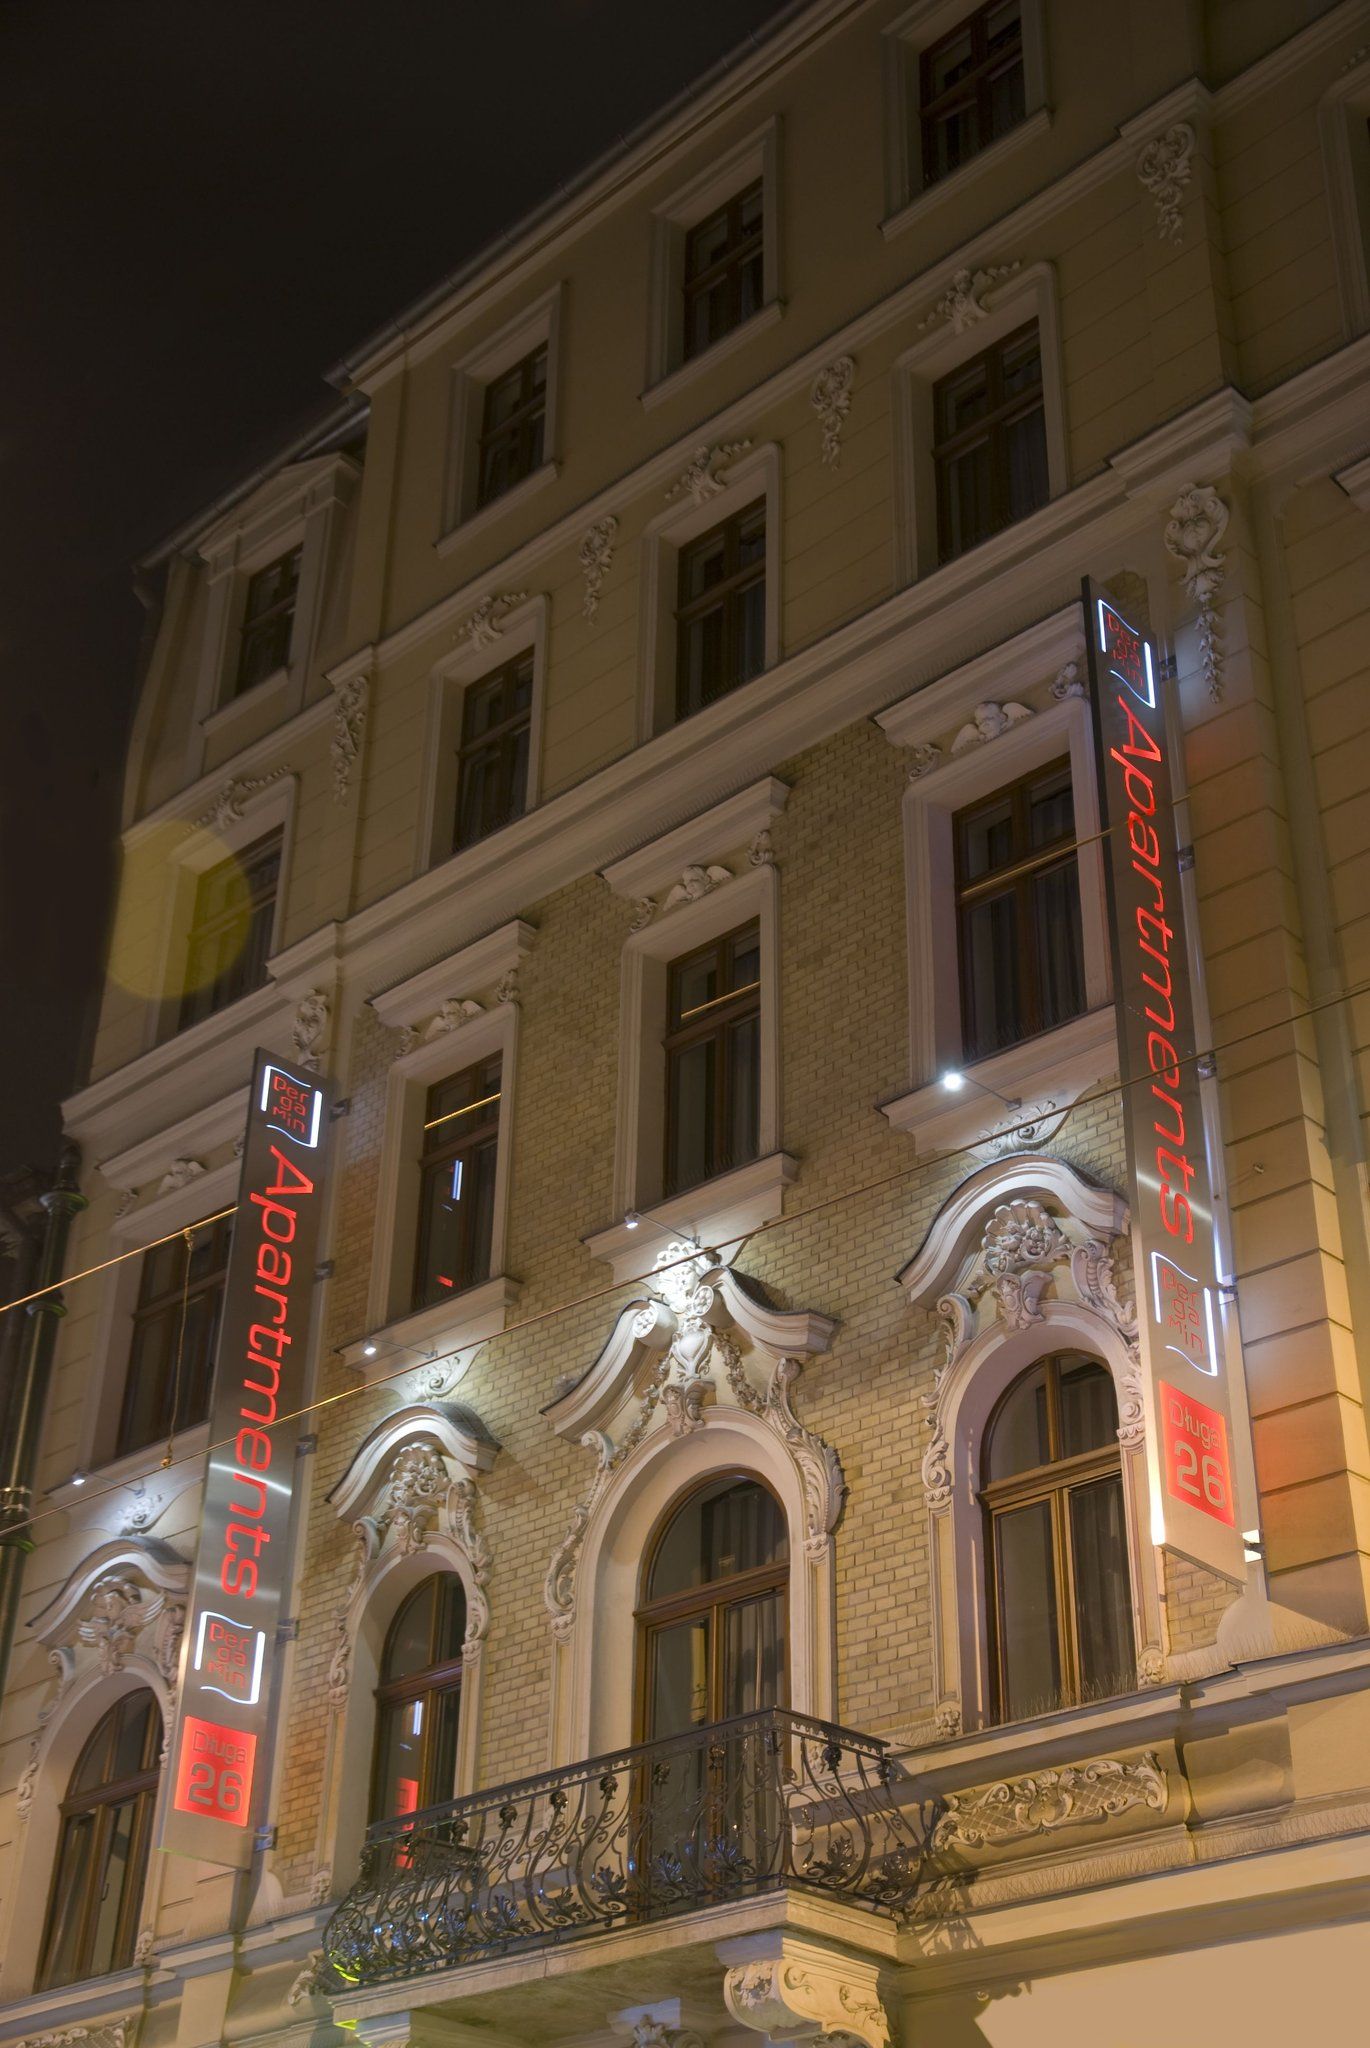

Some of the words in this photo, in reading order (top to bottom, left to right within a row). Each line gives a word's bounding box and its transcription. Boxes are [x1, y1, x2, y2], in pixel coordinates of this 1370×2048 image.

[1111, 695, 1195, 1244] Apartments
[273, 1076, 310, 1104] Per
[279, 1096, 306, 1117] ga
[1162, 1266, 1199, 1307] Per
[1172, 1298, 1200, 1327] ga
[220, 1144, 314, 1600] Apartments
[1169, 1400, 1222, 1450] Długa
[1175, 1440, 1226, 1510] 26
[209, 1622, 250, 1651] Per
[217, 1646, 248, 1667] ga
[192, 1730, 247, 1766] Długa
[187, 1761, 244, 1812] 26
